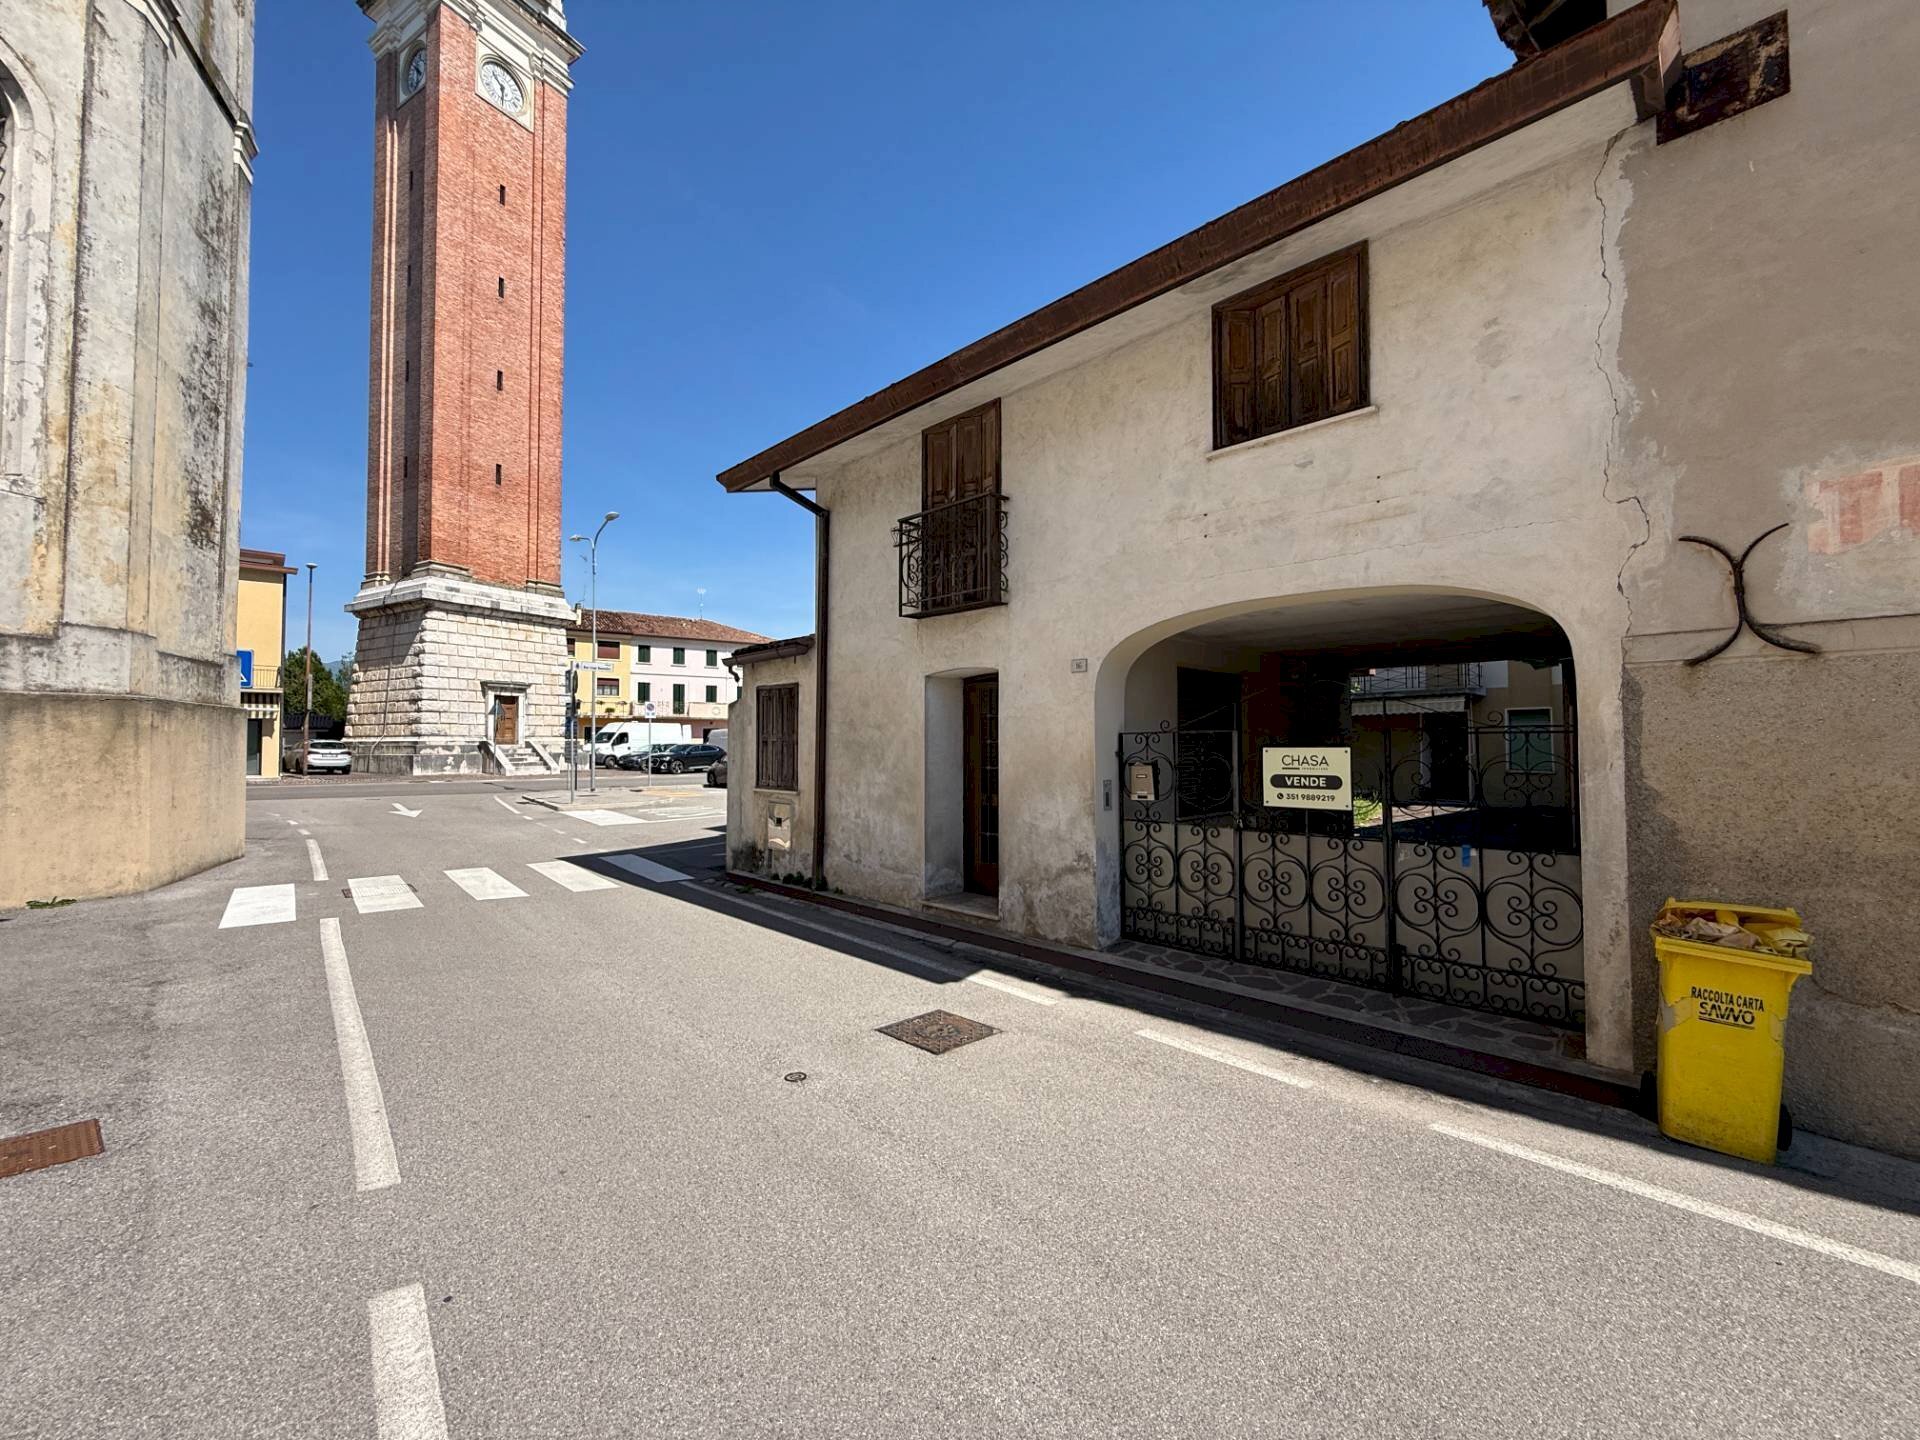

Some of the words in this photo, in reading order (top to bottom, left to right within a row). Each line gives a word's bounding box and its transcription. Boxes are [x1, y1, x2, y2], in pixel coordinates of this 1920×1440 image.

[1282, 755, 1328, 766] CHASA
[1285, 776, 1327, 787] VENDE
[1691, 987, 1734, 1006] RACCOLTA
[1737, 995, 1764, 1012] CARTA
